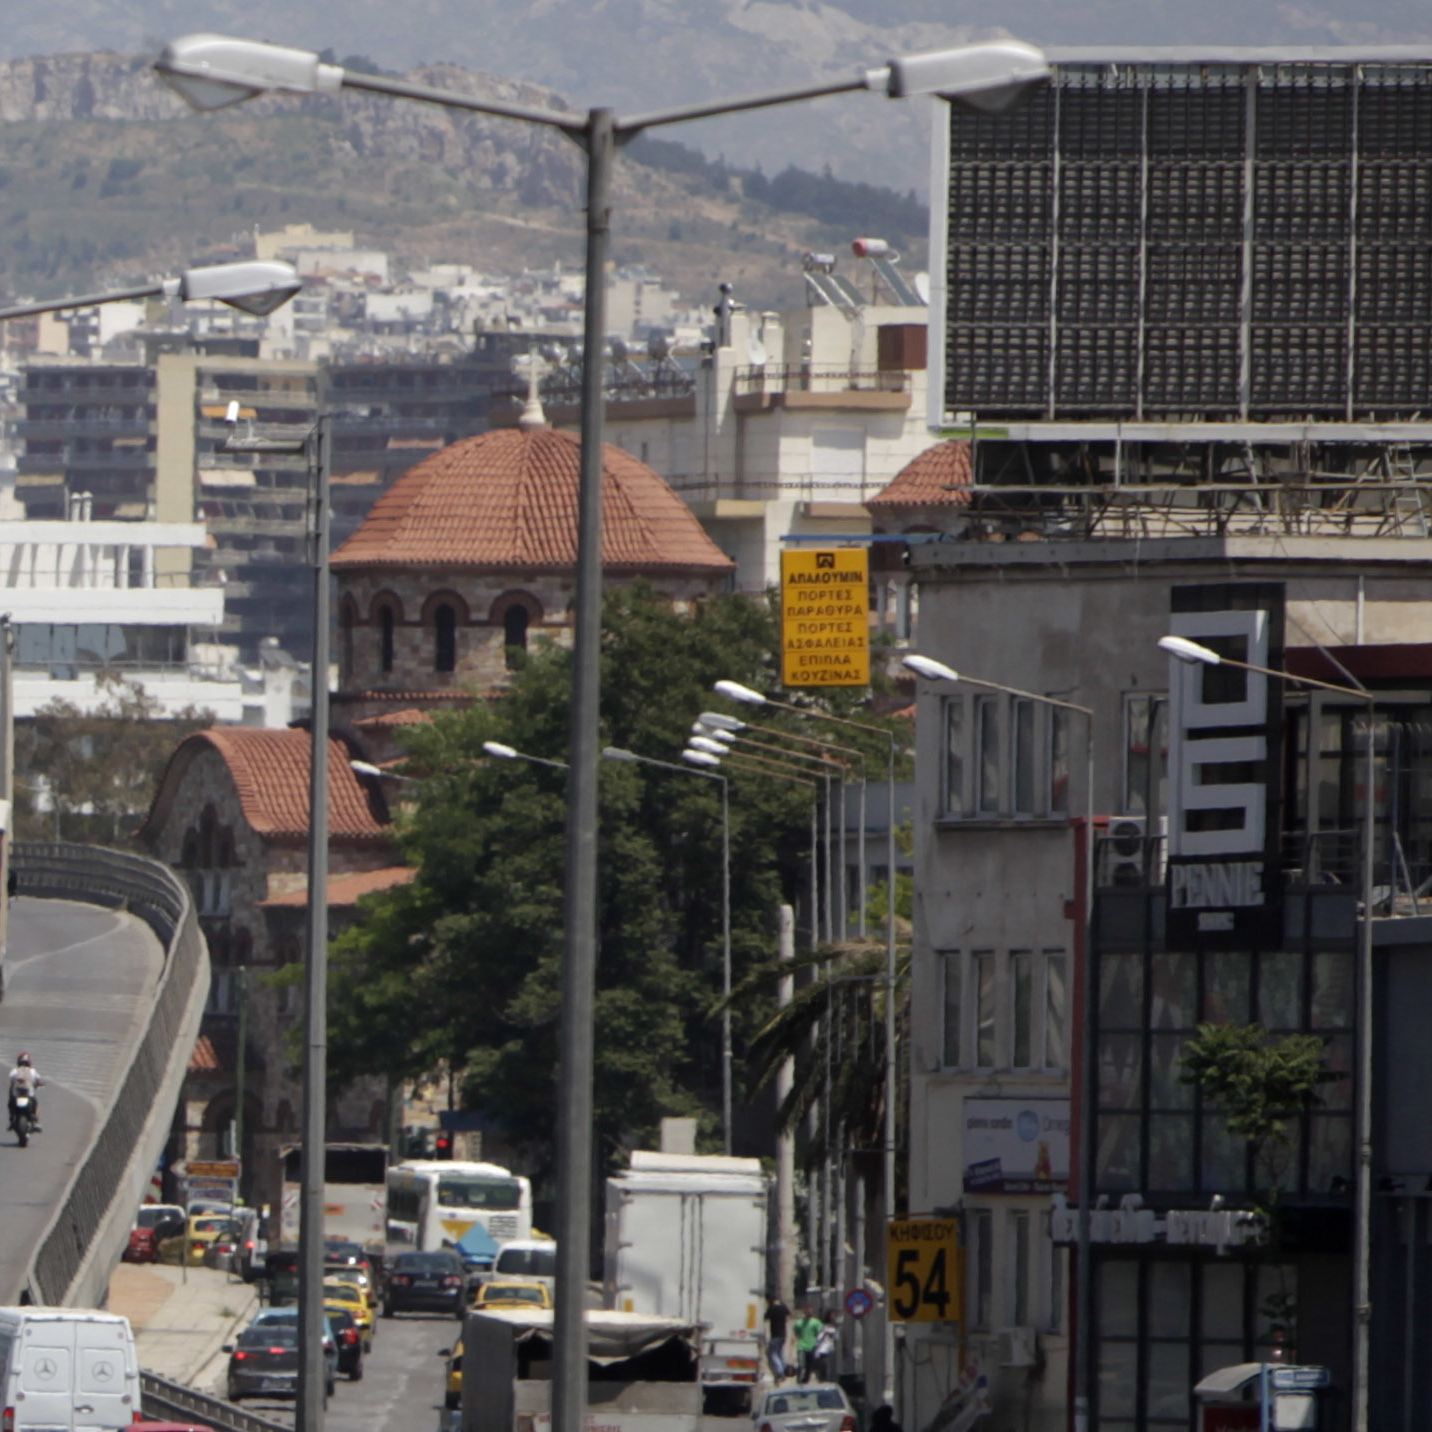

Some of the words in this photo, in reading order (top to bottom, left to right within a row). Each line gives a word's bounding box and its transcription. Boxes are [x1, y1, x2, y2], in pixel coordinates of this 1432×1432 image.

[798, 590, 853, 601] ΠΟΡΤΕΣ
[787, 605, 863, 617] ΠΑΡΑΘΥΡΑ
[798, 623, 853, 634] ΠΟΡΤΕΣ
[787, 637, 865, 649] ΑΣΦΑΛΕΙΑΣ
[799, 655, 852, 666] ΕΠΙΠΛΑ
[791, 670, 861, 681] ΚΟΥΖΙΝΑΣ
[893, 1247, 951, 1319] 54
